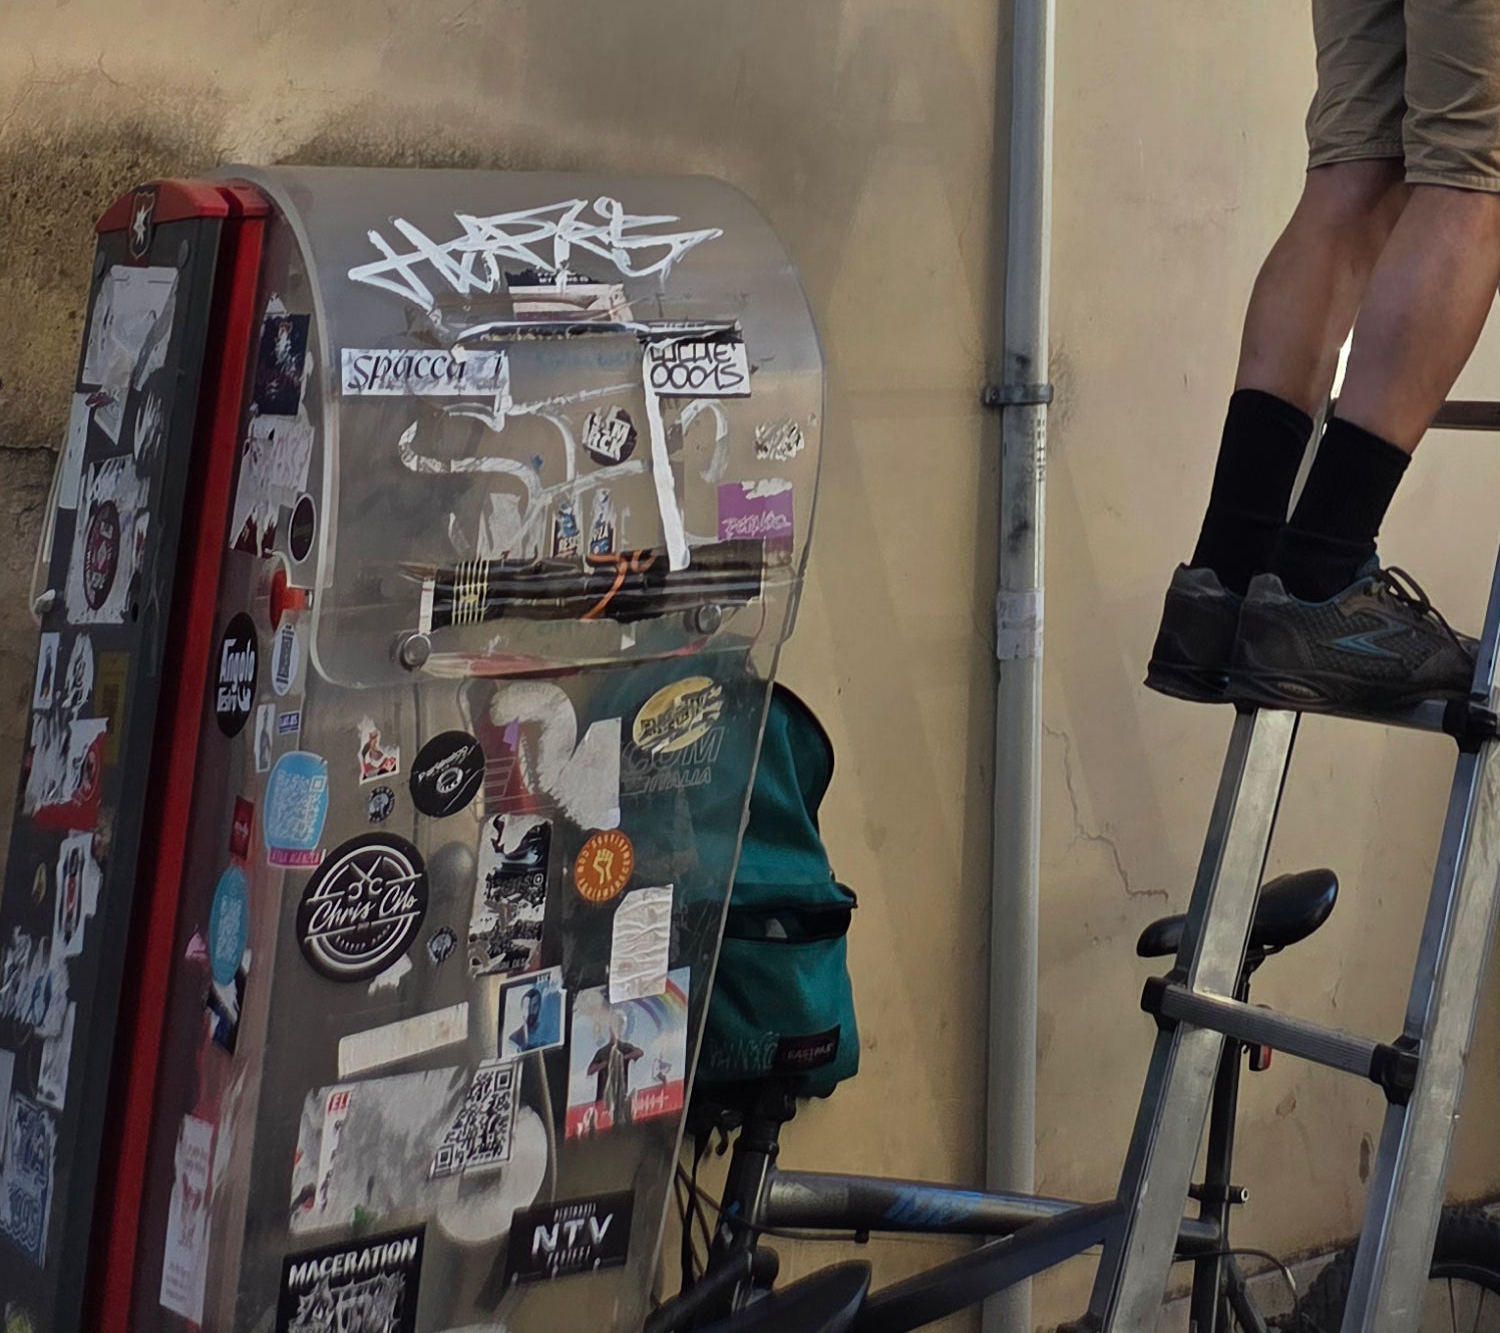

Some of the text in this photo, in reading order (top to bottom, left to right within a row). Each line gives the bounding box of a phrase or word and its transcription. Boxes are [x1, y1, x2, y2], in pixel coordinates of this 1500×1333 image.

[308, 898, 376, 934] Chris
[531, 1213, 614, 1255] NTV
[288, 1237, 418, 1288] MACERATION
